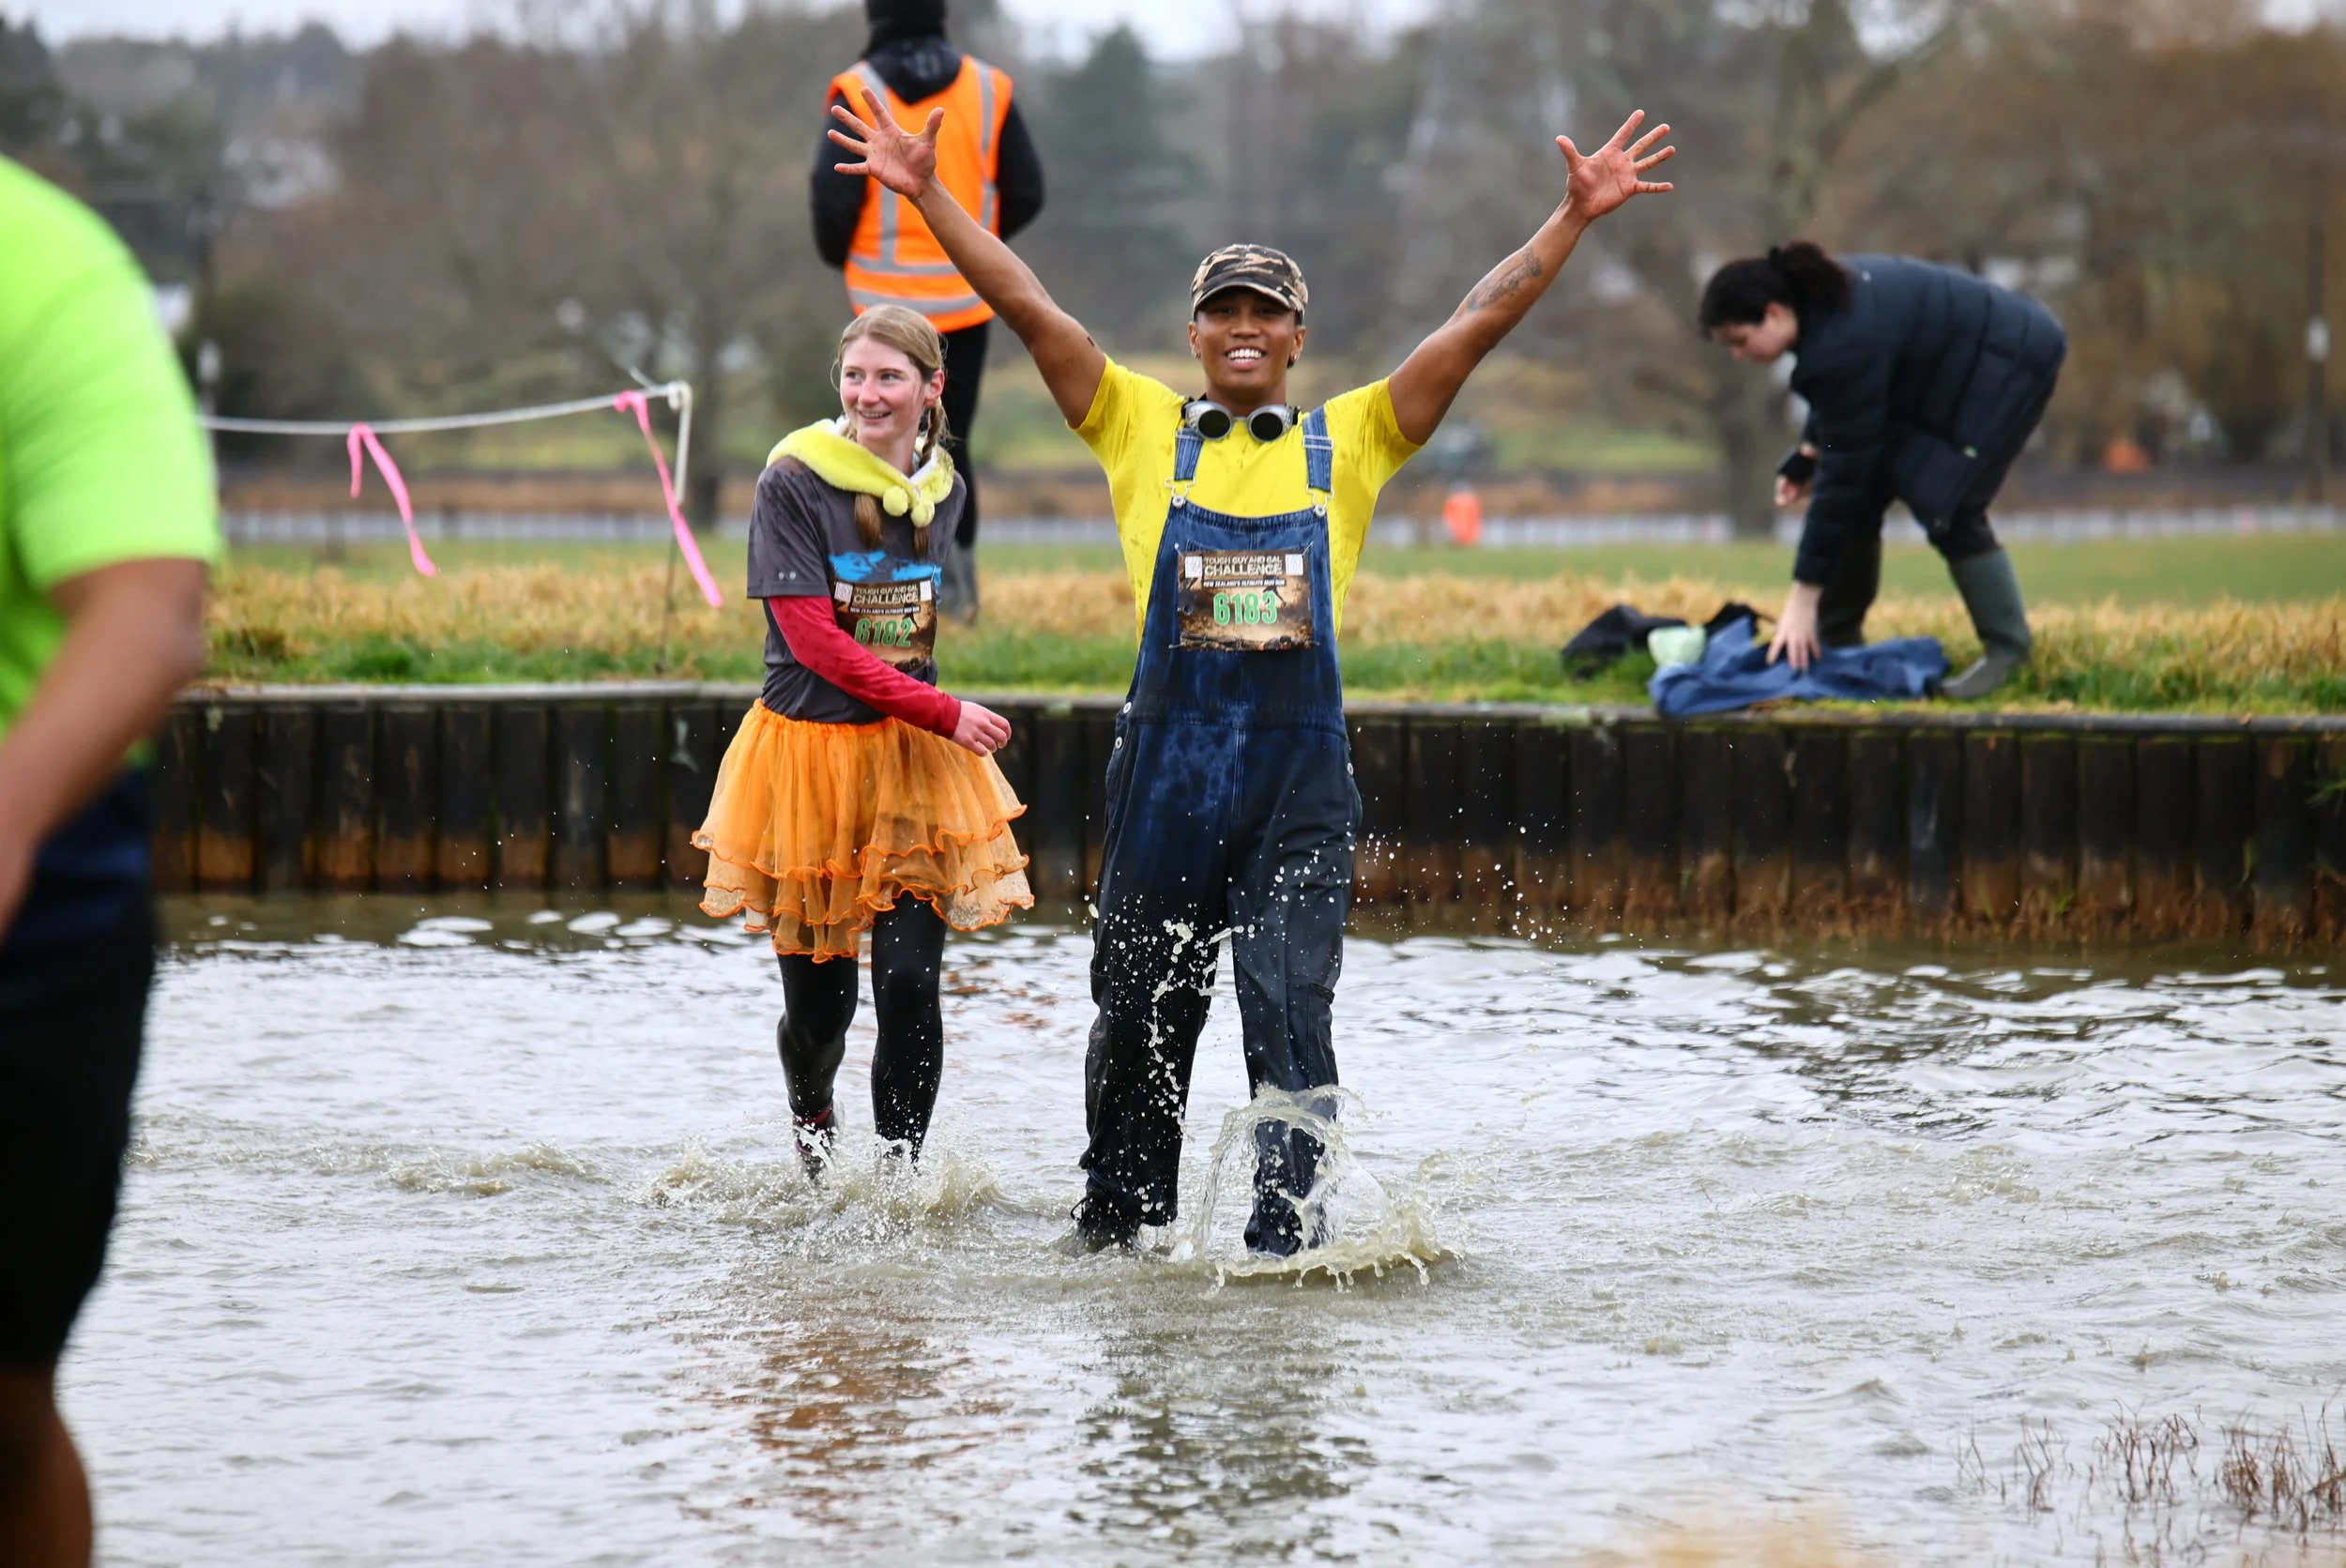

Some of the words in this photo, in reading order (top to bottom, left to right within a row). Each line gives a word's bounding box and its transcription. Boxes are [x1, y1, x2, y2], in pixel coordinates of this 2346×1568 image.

[1205, 556, 1231, 565] TOUGH
[1232, 556, 1248, 564] GUY
[1249, 556, 1265, 564] AND
[1267, 555, 1282, 563] GAL
[1204, 563, 1283, 576] CHALLENGE
[853, 592, 919, 604] CHALLENGE
[1213, 592, 1277, 626] 6183
[855, 617, 913, 647] 6182
